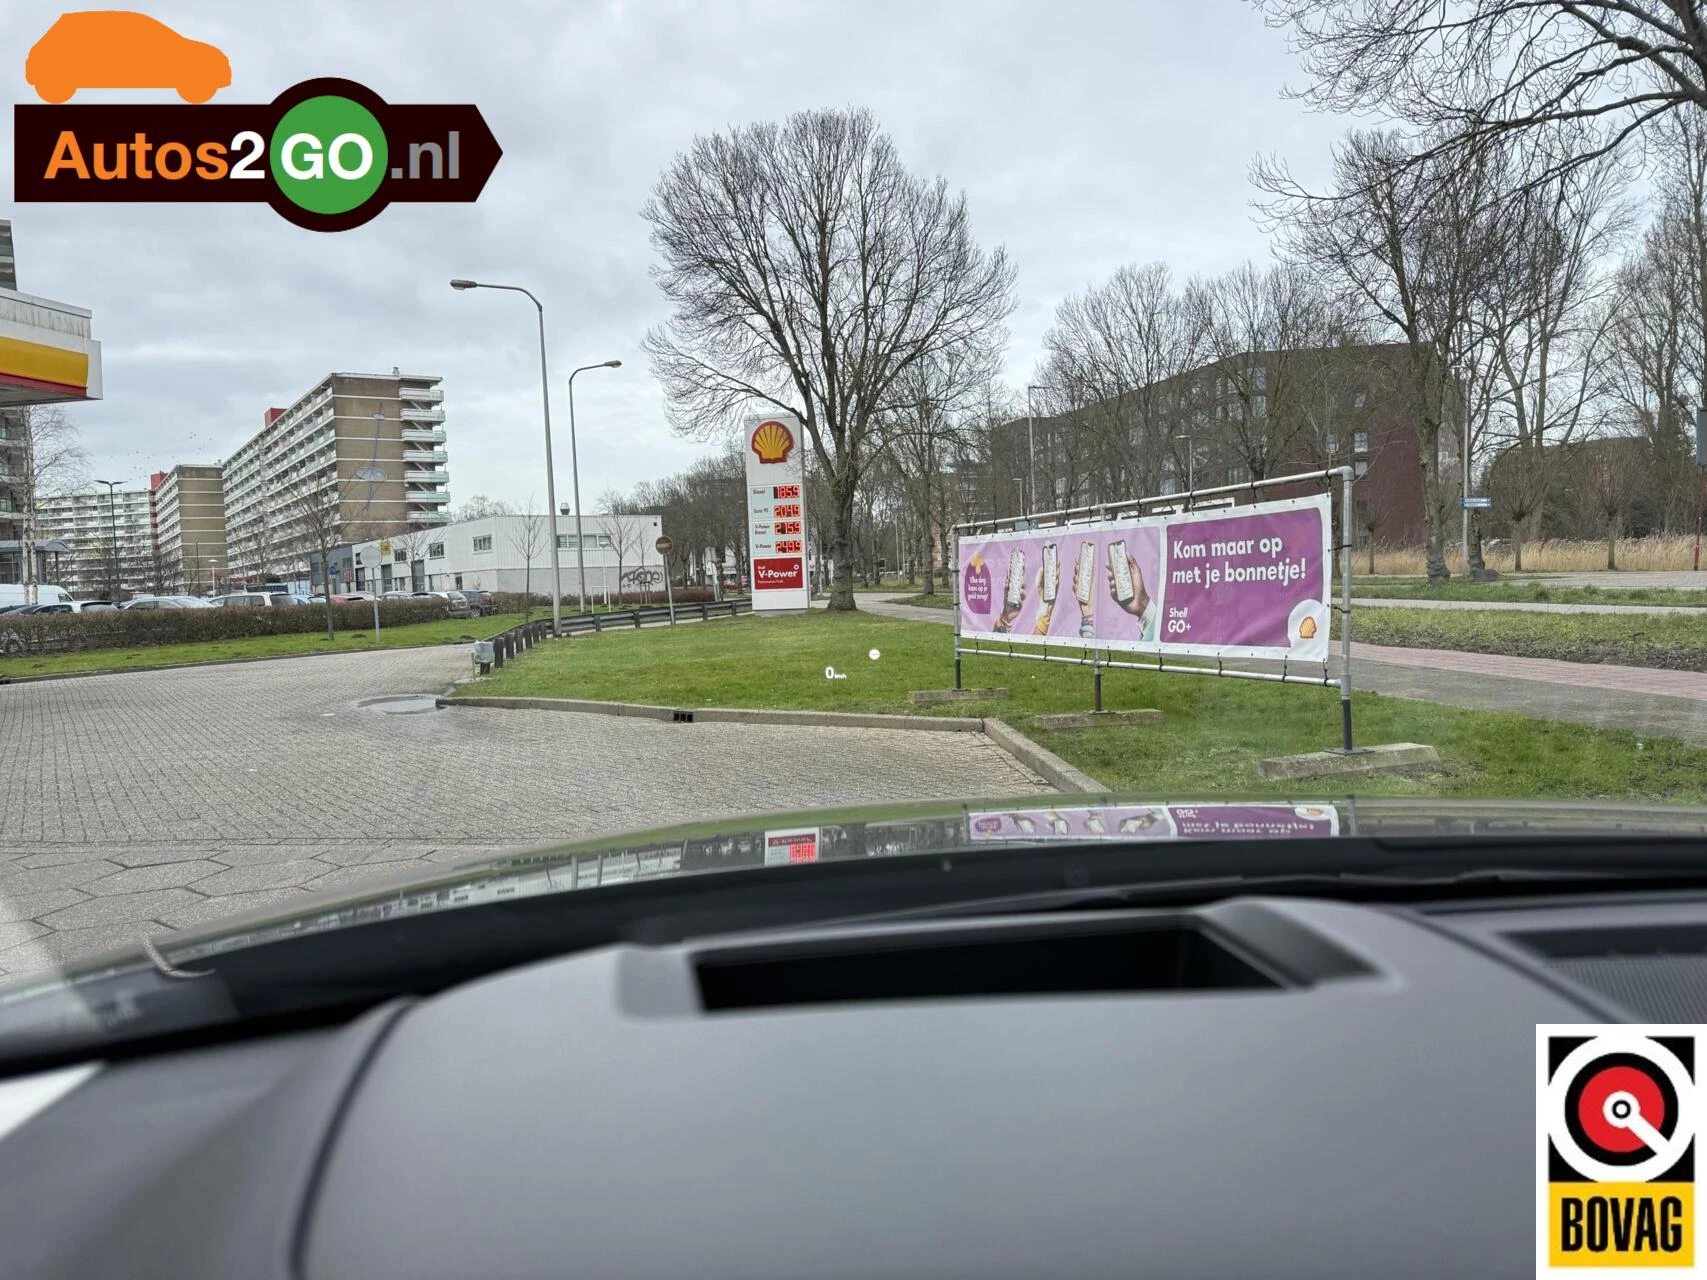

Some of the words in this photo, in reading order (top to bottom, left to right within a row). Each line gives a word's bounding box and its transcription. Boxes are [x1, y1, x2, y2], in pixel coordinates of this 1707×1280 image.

[1173, 540, 1206, 559] Kom
[1211, 540, 1254, 556] maar
[1259, 537, 1283, 558] op
[758, 569, 798, 578] V-Power
[1172, 567, 1201, 584] met
[1205, 563, 1220, 589] je
[1224, 557, 1306, 586] bonnetje!
[1169, 607, 1188, 618] Shell
[1168, 620, 1192, 633] GO+
[825, 666, 834, 679] 0
